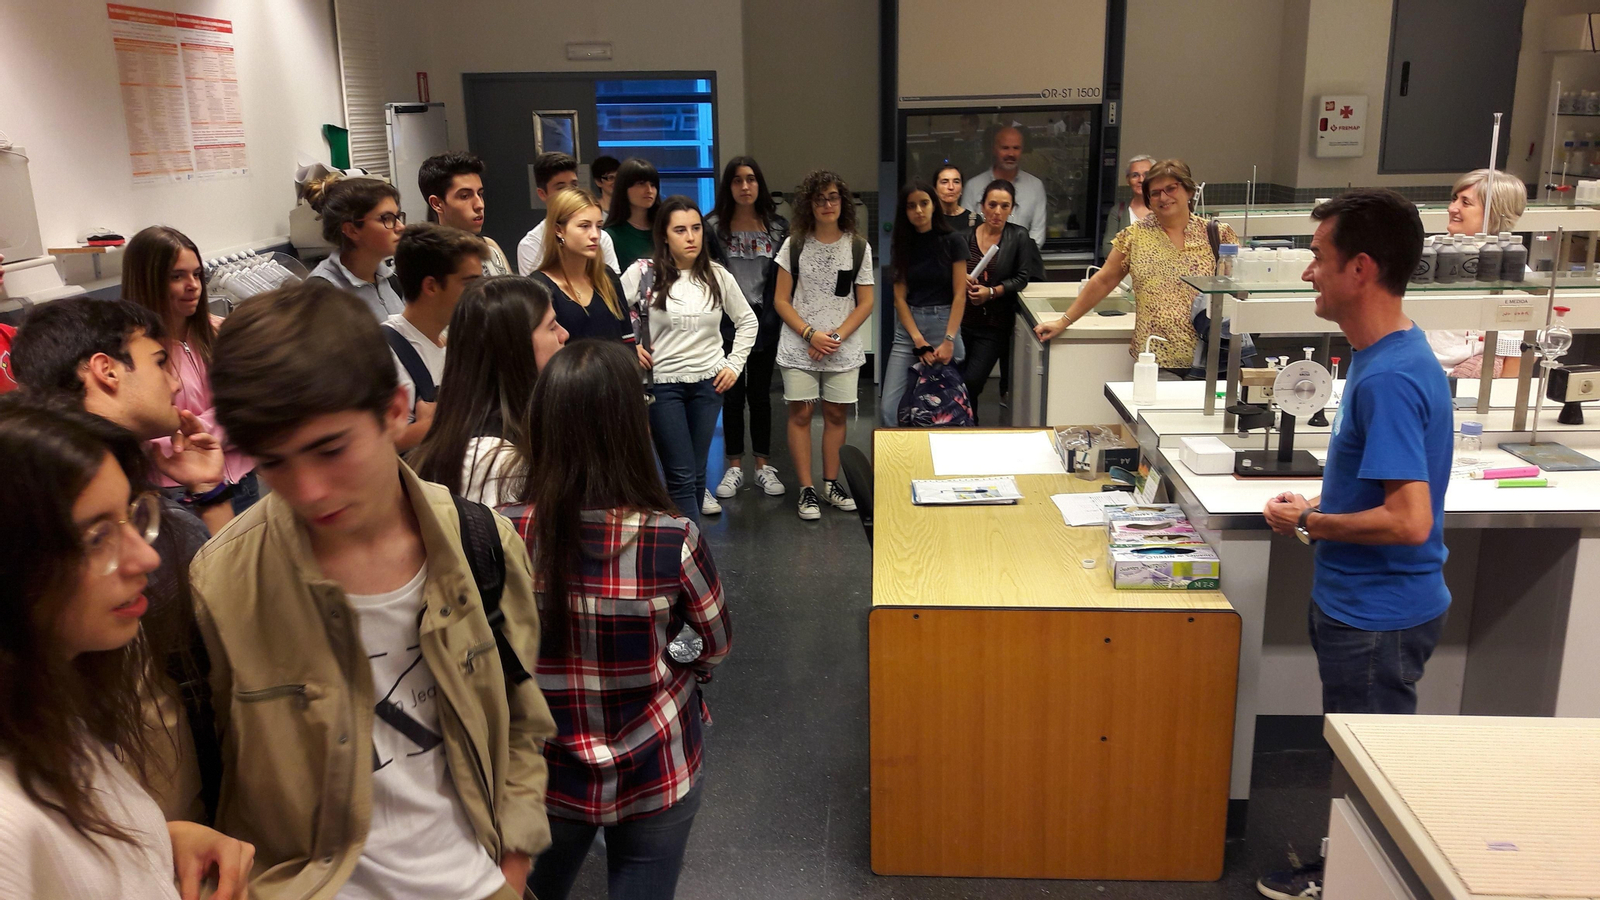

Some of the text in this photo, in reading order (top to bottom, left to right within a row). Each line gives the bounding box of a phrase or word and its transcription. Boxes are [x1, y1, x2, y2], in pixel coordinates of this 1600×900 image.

[1077, 88, 1100, 98] 1500
[671, 314, 701, 332] FUN
[1120, 457, 1131, 465] A4
[411, 686, 437, 708] Jea
